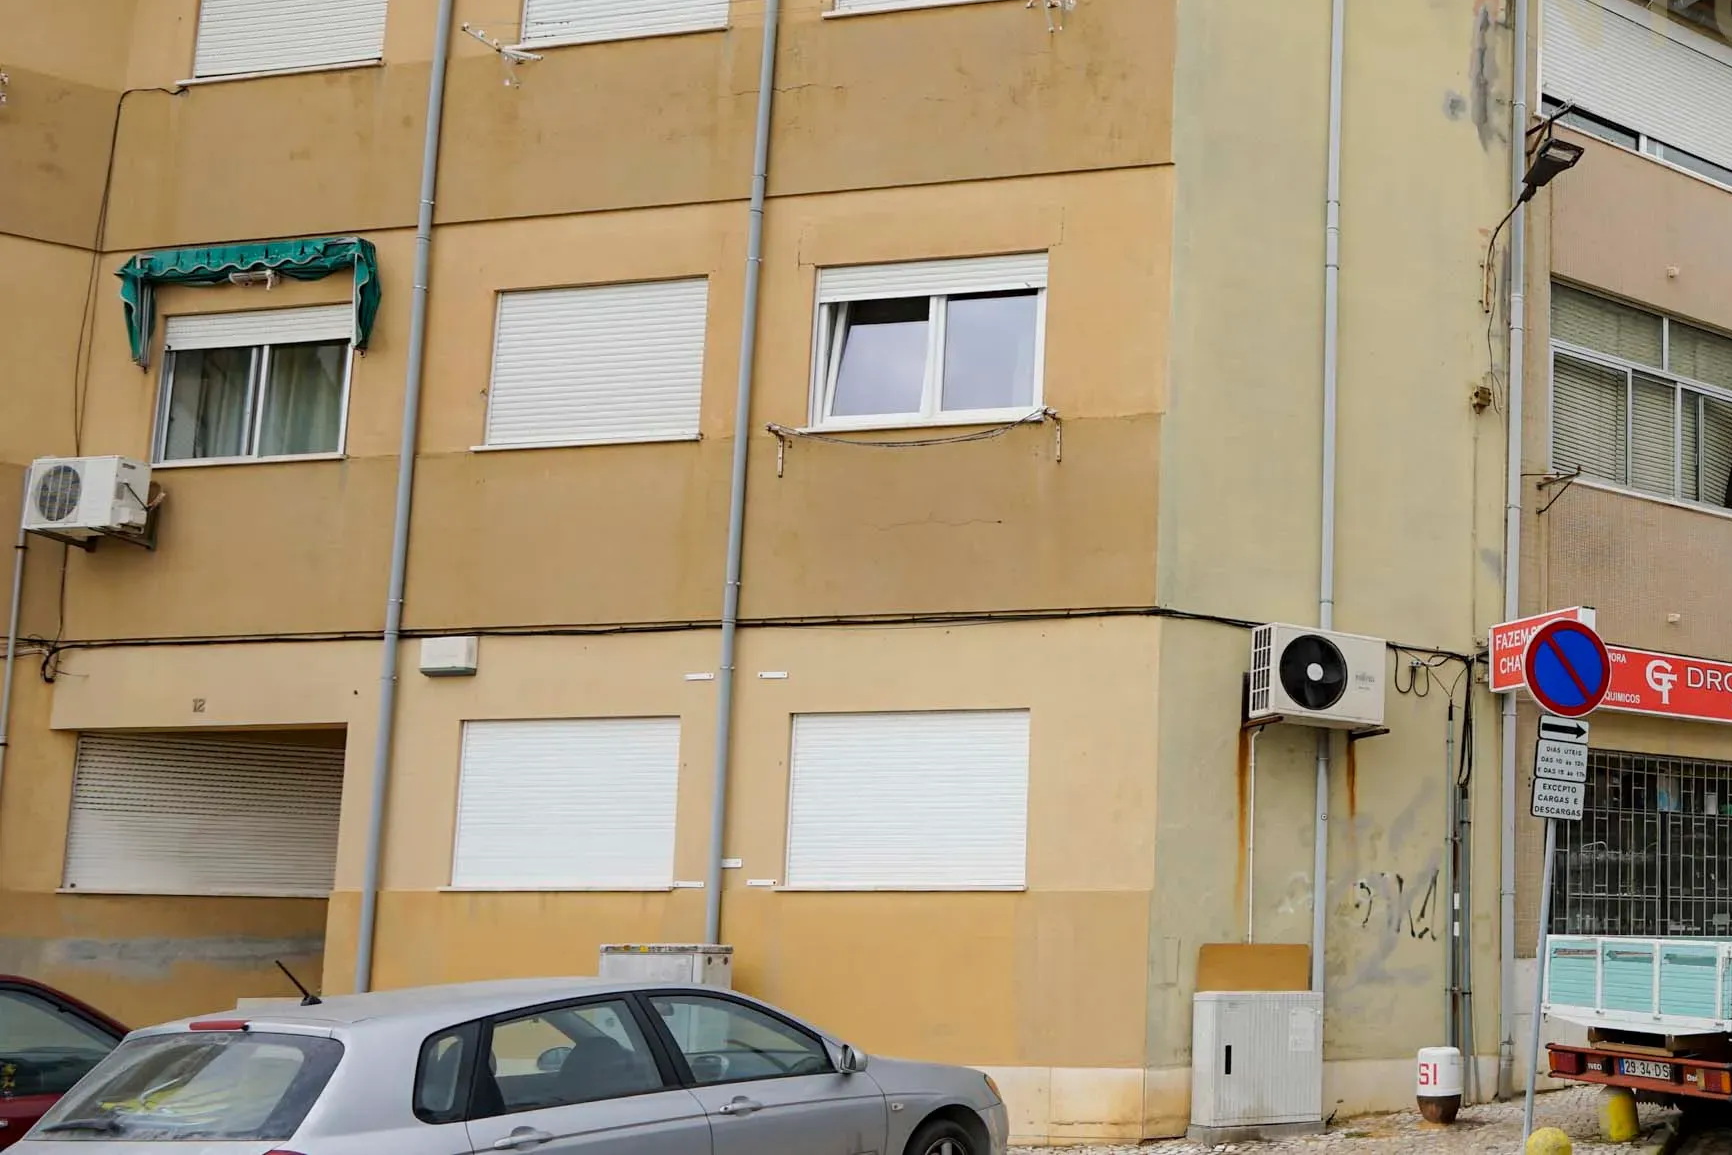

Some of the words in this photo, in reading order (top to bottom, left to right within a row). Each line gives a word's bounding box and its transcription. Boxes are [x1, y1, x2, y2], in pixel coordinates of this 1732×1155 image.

[1495, 625, 1540, 651] FAZEM-S
[192, 698, 206, 713] 12
[1537, 794, 1570, 805] CARGAS
[1534, 805, 1581, 817] DESCARGAS
